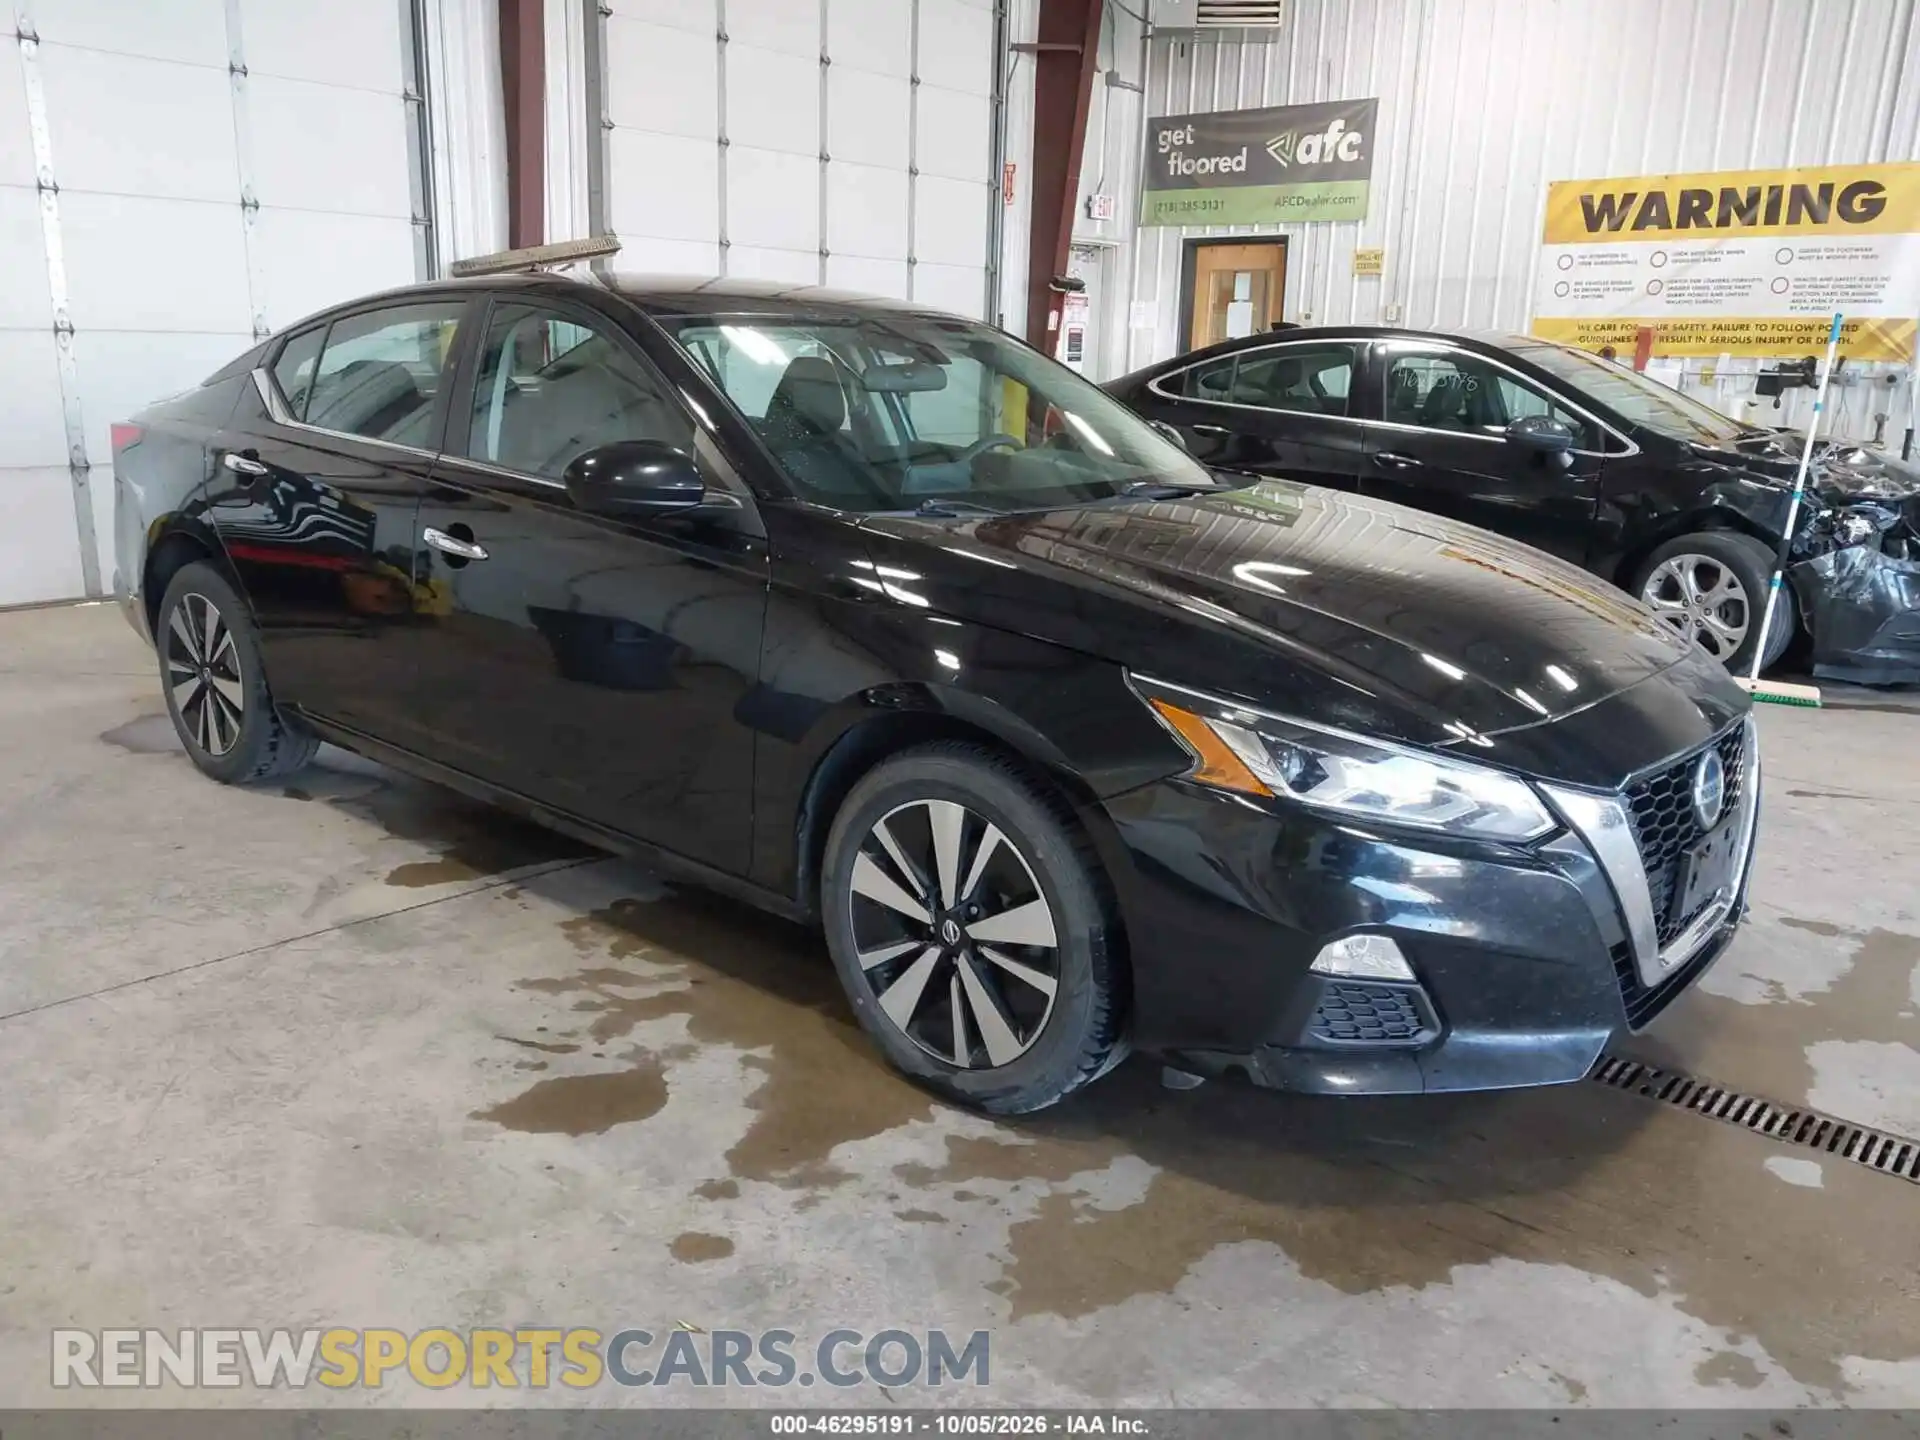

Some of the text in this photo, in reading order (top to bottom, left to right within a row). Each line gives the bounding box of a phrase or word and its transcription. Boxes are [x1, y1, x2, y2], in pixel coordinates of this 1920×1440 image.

[1158, 124, 1195, 153] get
[1168, 147, 1247, 176] floored
[1274, 194, 1356, 208] AFCDealer.com
[1579, 180, 1887, 233] WARNING
[1593, 324, 1616, 332] CARE
[1711, 323, 1750, 332] FAILURE
[1755, 323, 1767, 332] TO
[1771, 323, 1815, 332] FOLLOW
[1818, 323, 1860, 332] POTED
[1578, 335, 1632, 344] GUIDELINES
[1659, 335, 1692, 344] RESULT
[1695, 335, 1706, 343] IN
[1710, 335, 1752, 344] SERIOUS
[1755, 335, 1793, 344] INJURY
[1796, 335, 1812, 344] OR
[1816, 336, 1854, 345] DETH.
